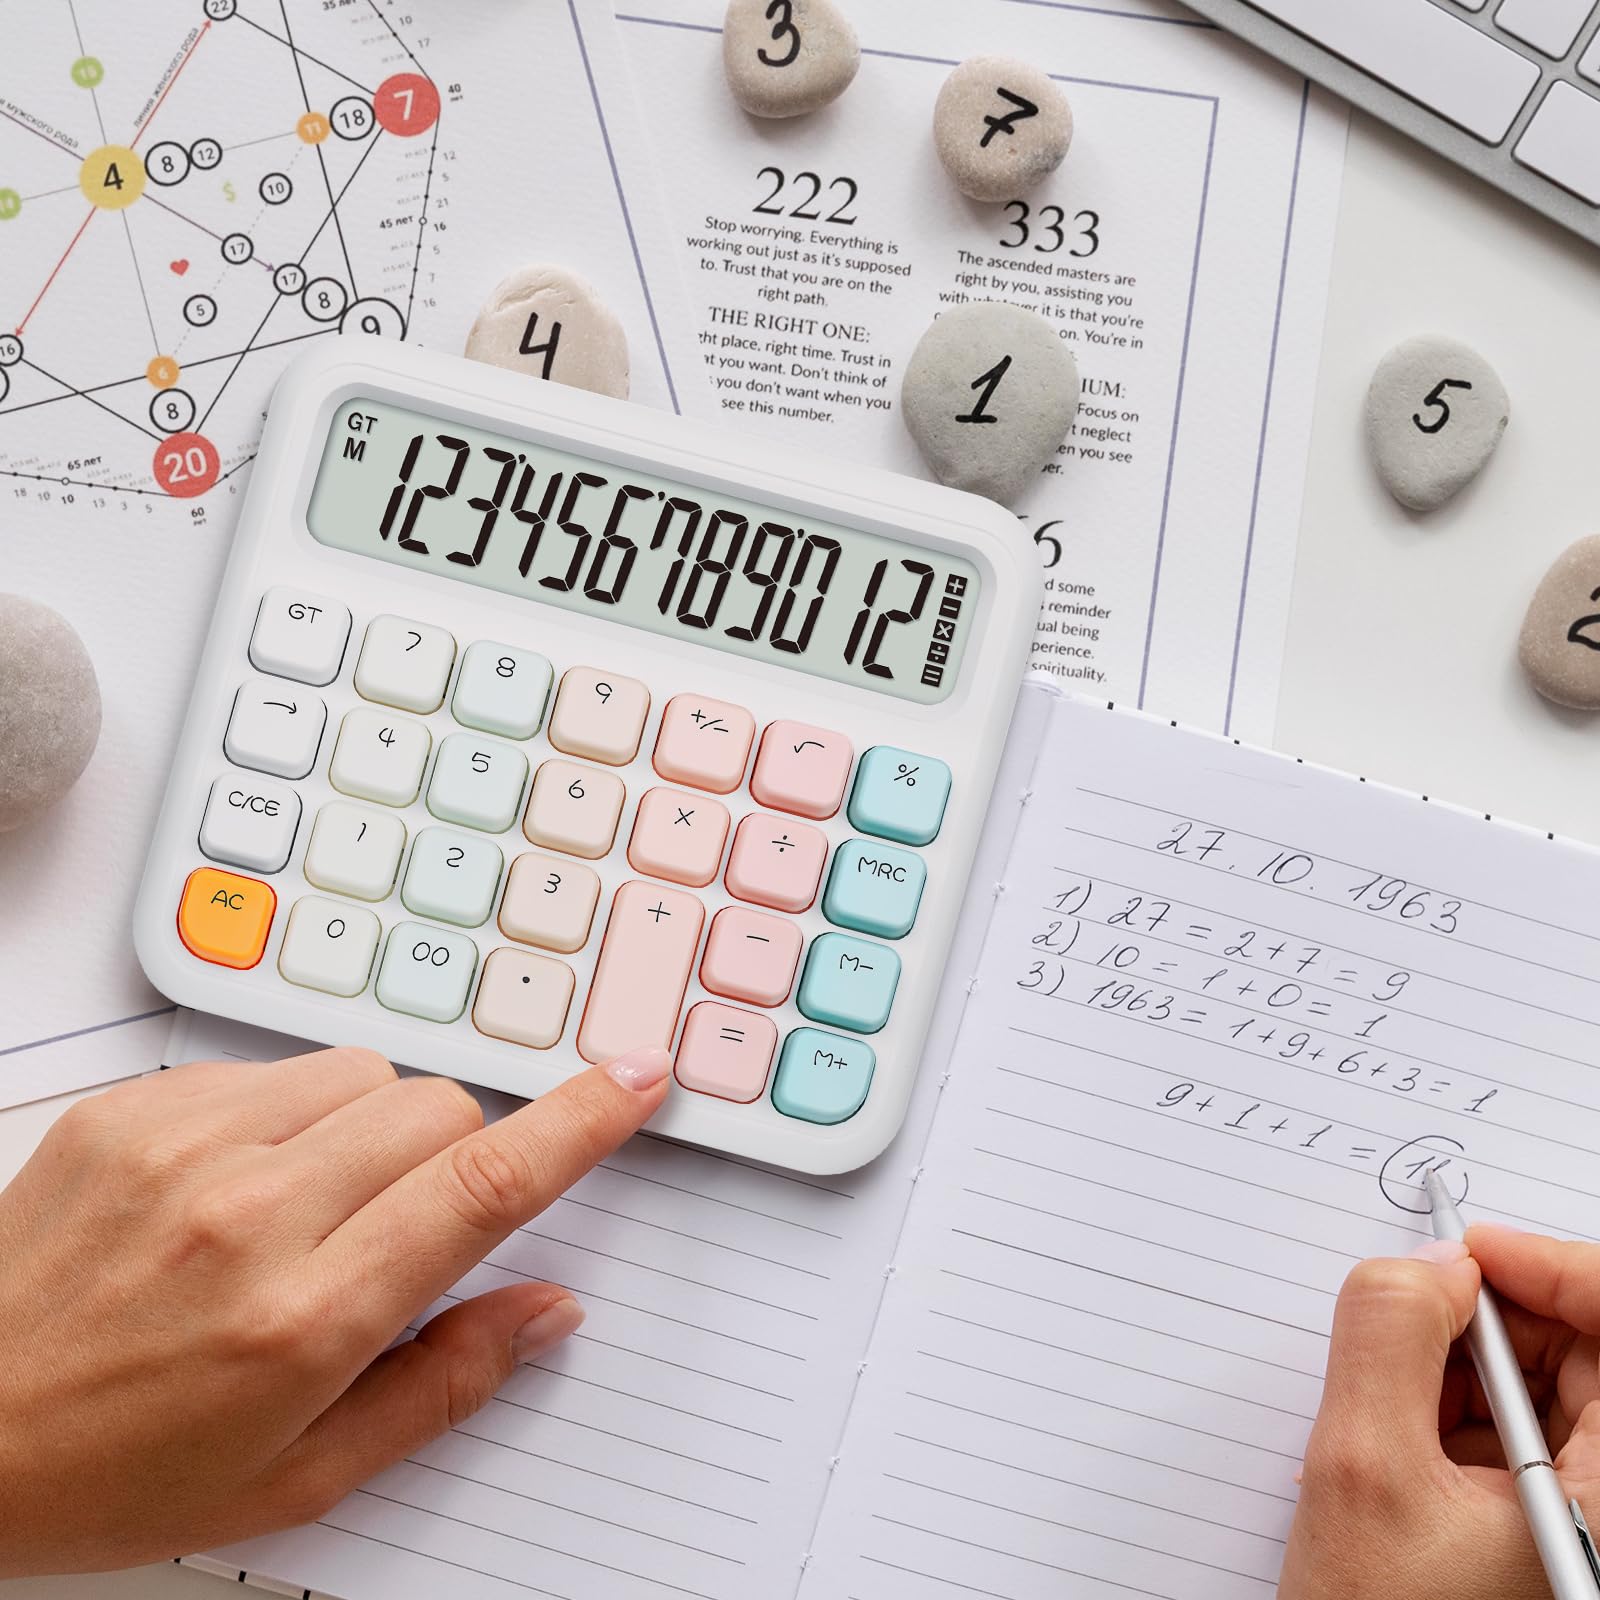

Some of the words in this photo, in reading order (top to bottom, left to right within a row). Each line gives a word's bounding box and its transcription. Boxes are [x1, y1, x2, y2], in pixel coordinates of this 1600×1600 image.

[211, 0, 229, 13] 22
[323, 0, 336, 11] 35
[399, 15, 413, 26] 10
[417, 37, 431, 49] 17
[757, 0, 801, 67] 3
[448, 82, 462, 94] 40
[393, 88, 415, 121] 7
[339, 108, 365, 129] 18
[979, 87, 1039, 148] 7
[161, 156, 175, 173] 8
[197, 147, 215, 162] 12
[443, 150, 457, 161] 12
[103, 162, 124, 191] 4
[267, 181, 285, 197] 10
[752, 166, 859, 226] 222
[435, 198, 449, 209] 21
[379, 218, 394, 230] 45
[434, 221, 448, 232] 16
[999, 200, 1101, 258] 333
[705, 216, 738, 234] Stop
[740, 222, 806, 244] worrying.
[810, 230, 884, 256] Everything
[887, 240, 899, 255] is
[230, 242, 246, 256] 17
[687, 235, 743, 257] working
[746, 244, 770, 259] out
[773, 246, 800, 262] just
[803, 253, 818, 265] as
[821, 252, 842, 267] it's
[845, 258, 912, 277] supposed
[281, 272, 298, 287] 17
[700, 258, 718, 272] to.
[722, 260, 757, 277] Trust
[761, 265, 788, 281] that
[792, 271, 818, 286] you
[821, 276, 844, 288] are
[847, 280, 866, 292] on
[869, 281, 893, 295] the
[957, 250, 983, 267] The
[986, 257, 1054, 277] ascended
[1056, 265, 1112, 285] masters
[1114, 274, 1137, 288] are
[318, 292, 331, 309] 8
[758, 286, 790, 303] right
[793, 291, 829, 308] path.
[955, 271, 988, 290] right
[991, 276, 1008, 292] by
[1044, 284, 1104, 307] assisting
[1106, 293, 1134, 308] you
[196, 304, 206, 318] 5
[423, 296, 437, 309] 16
[939, 291, 970, 306] with
[1041, 304, 1052, 317] it
[1055, 306, 1066, 319] is
[1070, 308, 1097, 324] that
[1101, 311, 1145, 330] you're
[361, 315, 382, 336] 9
[708, 306, 749, 327] THE
[754, 313, 819, 336] RIGHT
[822, 322, 871, 344] ONE:
[518, 311, 562, 380] 4
[1084, 330, 1128, 349] You're
[1131, 335, 1144, 350] in
[765, 341, 798, 358] right
[802, 346, 837, 362] time.
[841, 350, 875, 367] Trust
[878, 355, 892, 369] in
[719, 358, 745, 371] you
[749, 361, 787, 376] want.
[791, 364, 830, 382] Don't
[833, 368, 869, 387] think
[872, 375, 888, 389] of
[716, 376, 742, 391] you
[745, 380, 782, 396] don't
[785, 386, 820, 402] want
[824, 391, 863, 407] when
[865, 397, 893, 412] you
[955, 354, 1013, 424] 1
[166, 402, 180, 421] 8
[721, 398, 745, 410] see
[749, 400, 775, 415] this
[778, 406, 835, 424] number.
[1077, 403, 1118, 421] Focus
[1120, 411, 1140, 423] on
[1412, 378, 1472, 434] 5
[347, 411, 378, 434] GT
[1080, 425, 1132, 443] neglect
[343, 437, 367, 461] M
[1079, 447, 1105, 461] you
[1108, 452, 1133, 464] see
[67, 461, 82, 472] 65
[83, 455, 103, 468] лет
[163, 447, 208, 485] 20
[61, 494, 75, 506] 10
[191, 507, 206, 519] 60
[1058, 581, 1097, 597] some
[288, 603, 324, 624] GT
[1048, 602, 1113, 620] reminder
[405, 631, 422, 652] 7
[1061, 622, 1101, 642] being
[496, 656, 517, 678] 8
[595, 682, 613, 704] 9
[378, 726, 397, 749] 4
[471, 751, 493, 774] 5
[892, 763, 920, 787] %
[568, 779, 586, 800] 6
[228, 789, 282, 818] C/CE
[356, 822, 368, 843] 1
[446, 847, 466, 869] 2
[857, 856, 908, 885] MRC
[543, 873, 562, 895] 3
[209, 889, 246, 911] AC
[1347, 874, 1462, 934] 1963
[326, 918, 346, 939] 0
[411, 941, 451, 968] 00
[1107, 896, 1171, 932] 27
[1371, 971, 1411, 1002] 9
[1096, 943, 1141, 968] 10
[1354, 1013, 1388, 1039] 1
[1087, 979, 1175, 1021] 1963
[1463, 1088, 1499, 1114] 1
[812, 1048, 849, 1071] M+
